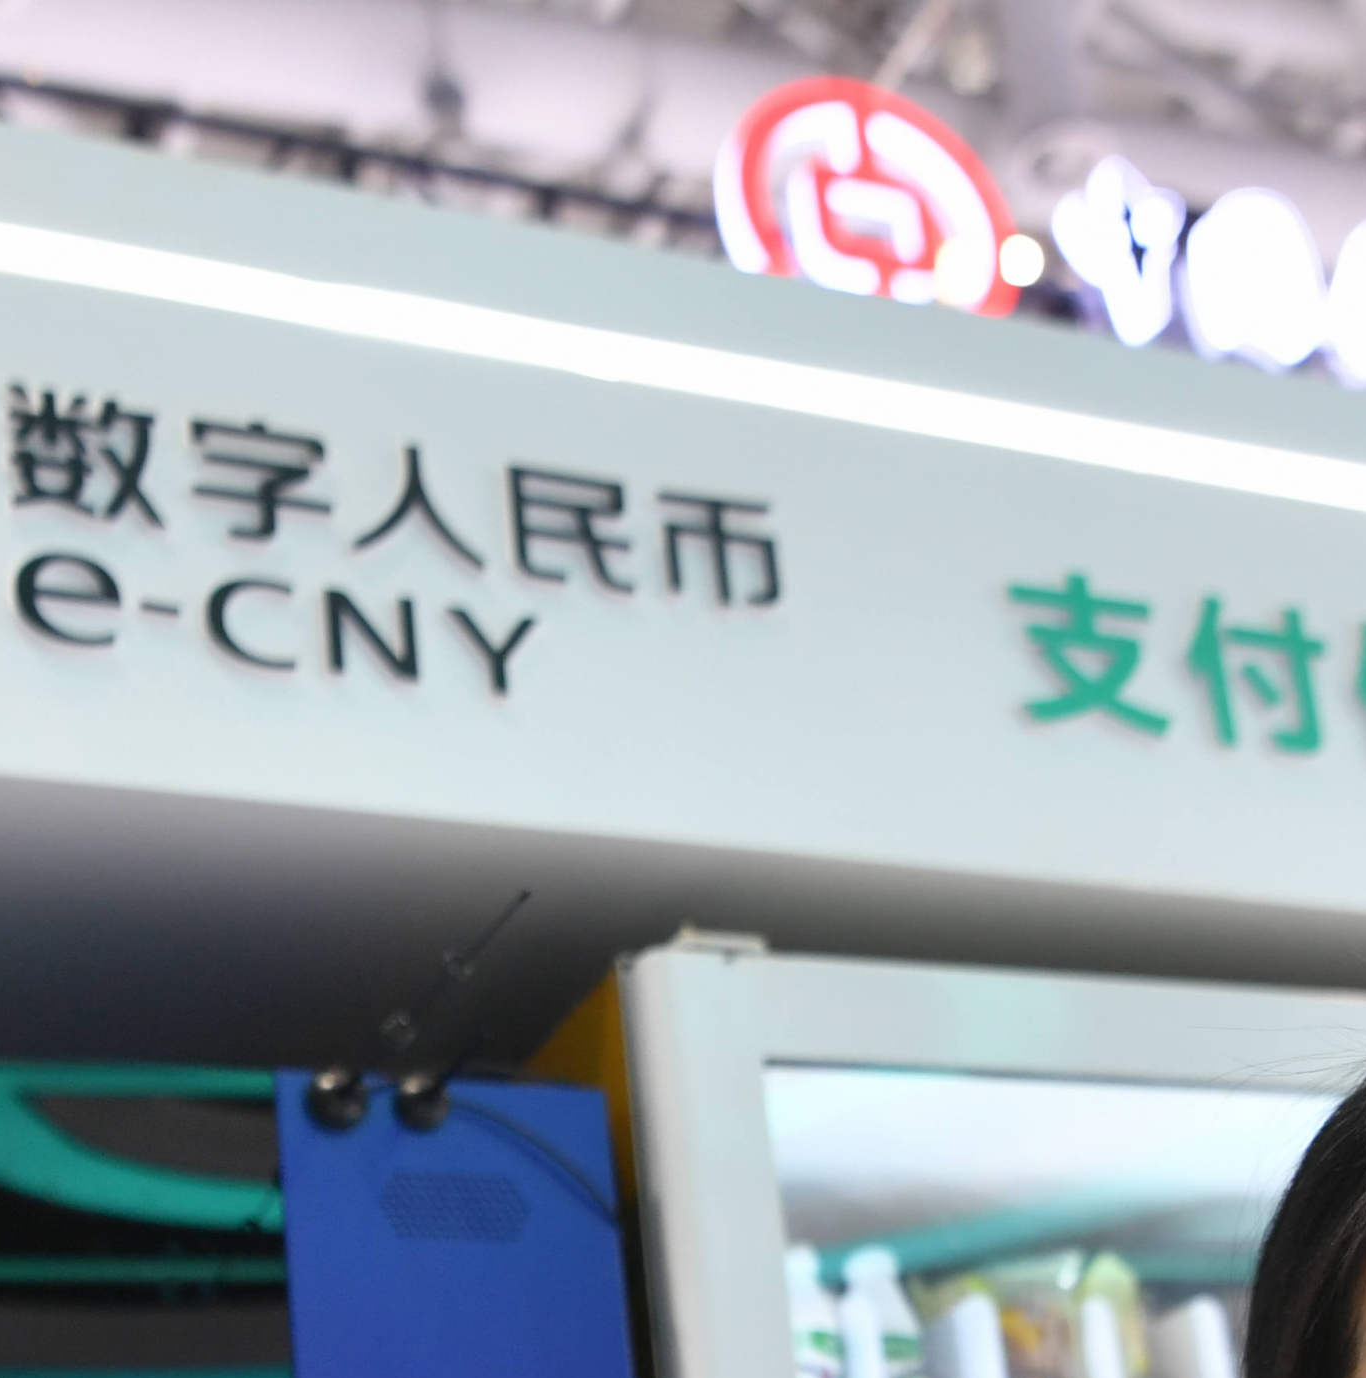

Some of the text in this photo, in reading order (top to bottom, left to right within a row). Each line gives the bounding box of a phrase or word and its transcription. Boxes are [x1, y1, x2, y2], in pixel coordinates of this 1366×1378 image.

[7, 380, 783, 608] 数字人民币
[15, 552, 535, 697] e-CNY
